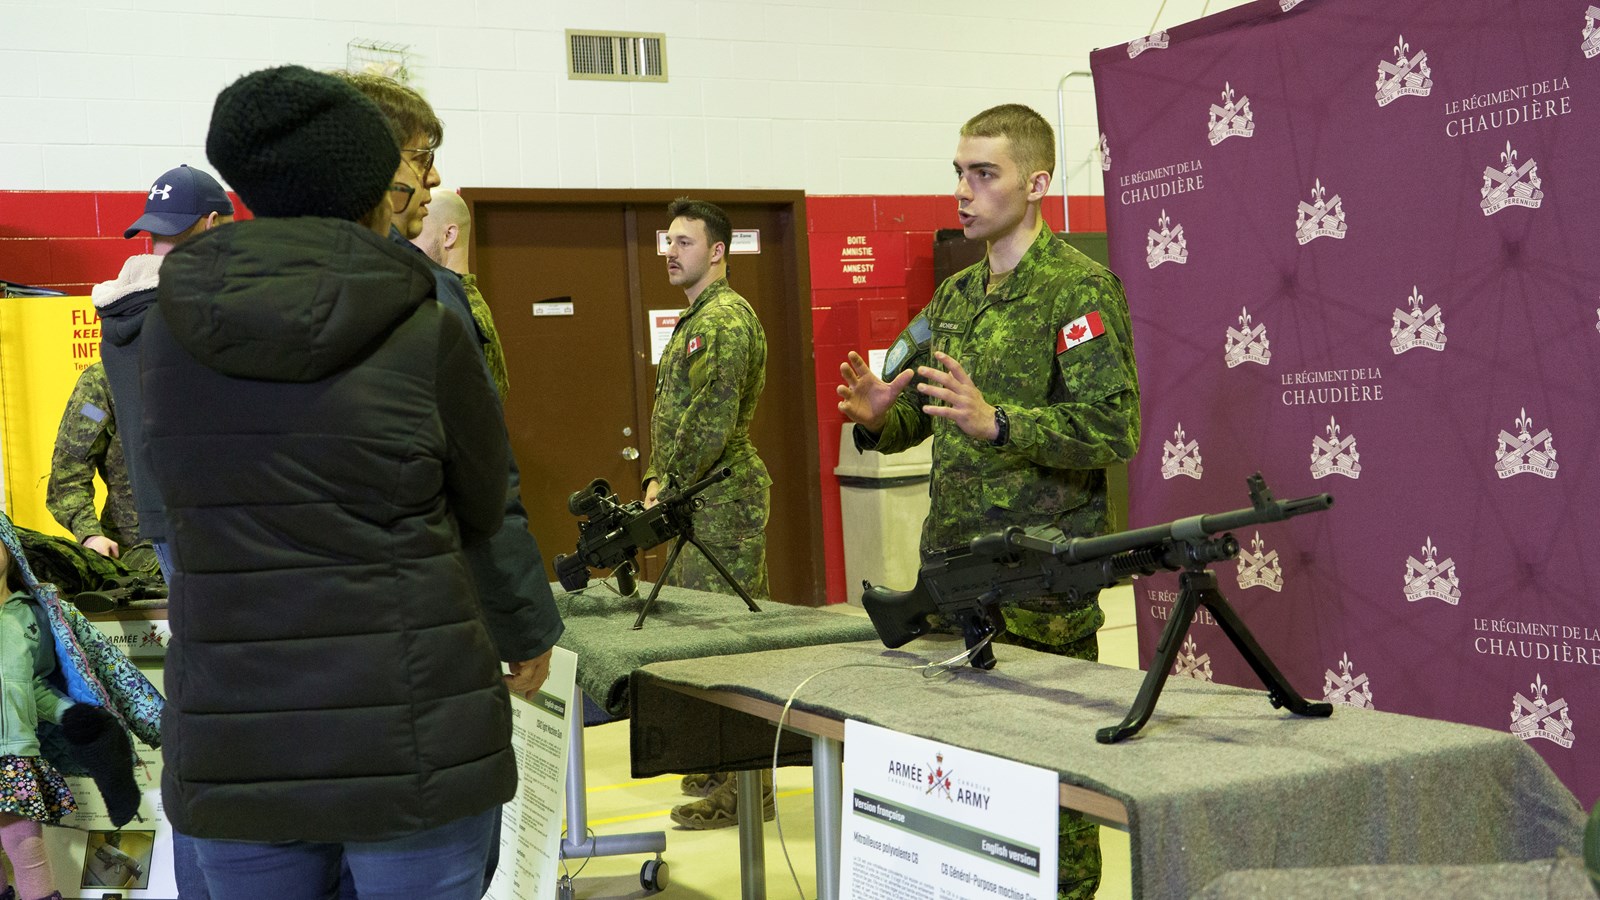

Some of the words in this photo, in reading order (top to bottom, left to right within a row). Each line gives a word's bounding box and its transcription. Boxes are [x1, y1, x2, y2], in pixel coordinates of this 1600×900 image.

[1588, 46, 1600, 56] AER
[1445, 101, 1460, 115] LE
[1462, 84, 1529, 112] RÉGIMENT
[1532, 80, 1550, 96] DE
[1553, 76, 1570, 92] LA
[1446, 96, 1572, 138] CHAUDIÈRE
[1120, 176, 1130, 187] LE
[1131, 165, 1176, 184] RÉGIMENT
[1177, 162, 1190, 174] DE
[1191, 160, 1202, 171] LA
[1121, 175, 1204, 205] CHAUDIÈRE
[1486, 204, 1501, 214] AERE
[1504, 198, 1539, 208] PERENNIUS
[847, 236, 866, 245] BOITE
[842, 246, 874, 256] AMNISTIE
[842, 264, 874, 273] AMNESTY
[852, 275, 866, 284] BOX
[1282, 374, 1294, 385] LE
[1296, 369, 1348, 384] RÉGIMENT
[1352, 368, 1366, 380] DE
[1368, 368, 1382, 379] LA
[1282, 382, 1384, 406] CHAUDIÈRE
[1500, 468, 1516, 477] AERE
[1519, 464, 1554, 478] PERENNIUS
[1148, 590, 1157, 600] LE
[1158, 590, 1178, 602] RÉGI
[1474, 618, 1488, 631] LE
[1491, 618, 1558, 638] RÉGIMENT
[1562, 626, 1581, 640] DE
[1584, 627, 1600, 642] LA
[1474, 636, 1600, 666] CHAUDIÈRE
[1534, 730, 1570, 748] PERENNIUS
[888, 760, 922, 782] ARMÉE
[854, 797, 876, 814] Version
[956, 788, 990, 810] ARMY
[877, 804, 906, 822] française
[854, 831, 882, 850] Mitrailleuse
[882, 842, 910, 862] polyvalente
[912, 852, 918, 864] C6
[982, 840, 1008, 858] English
[1009, 850, 1037, 868] version
[941, 862, 948, 876] C6
